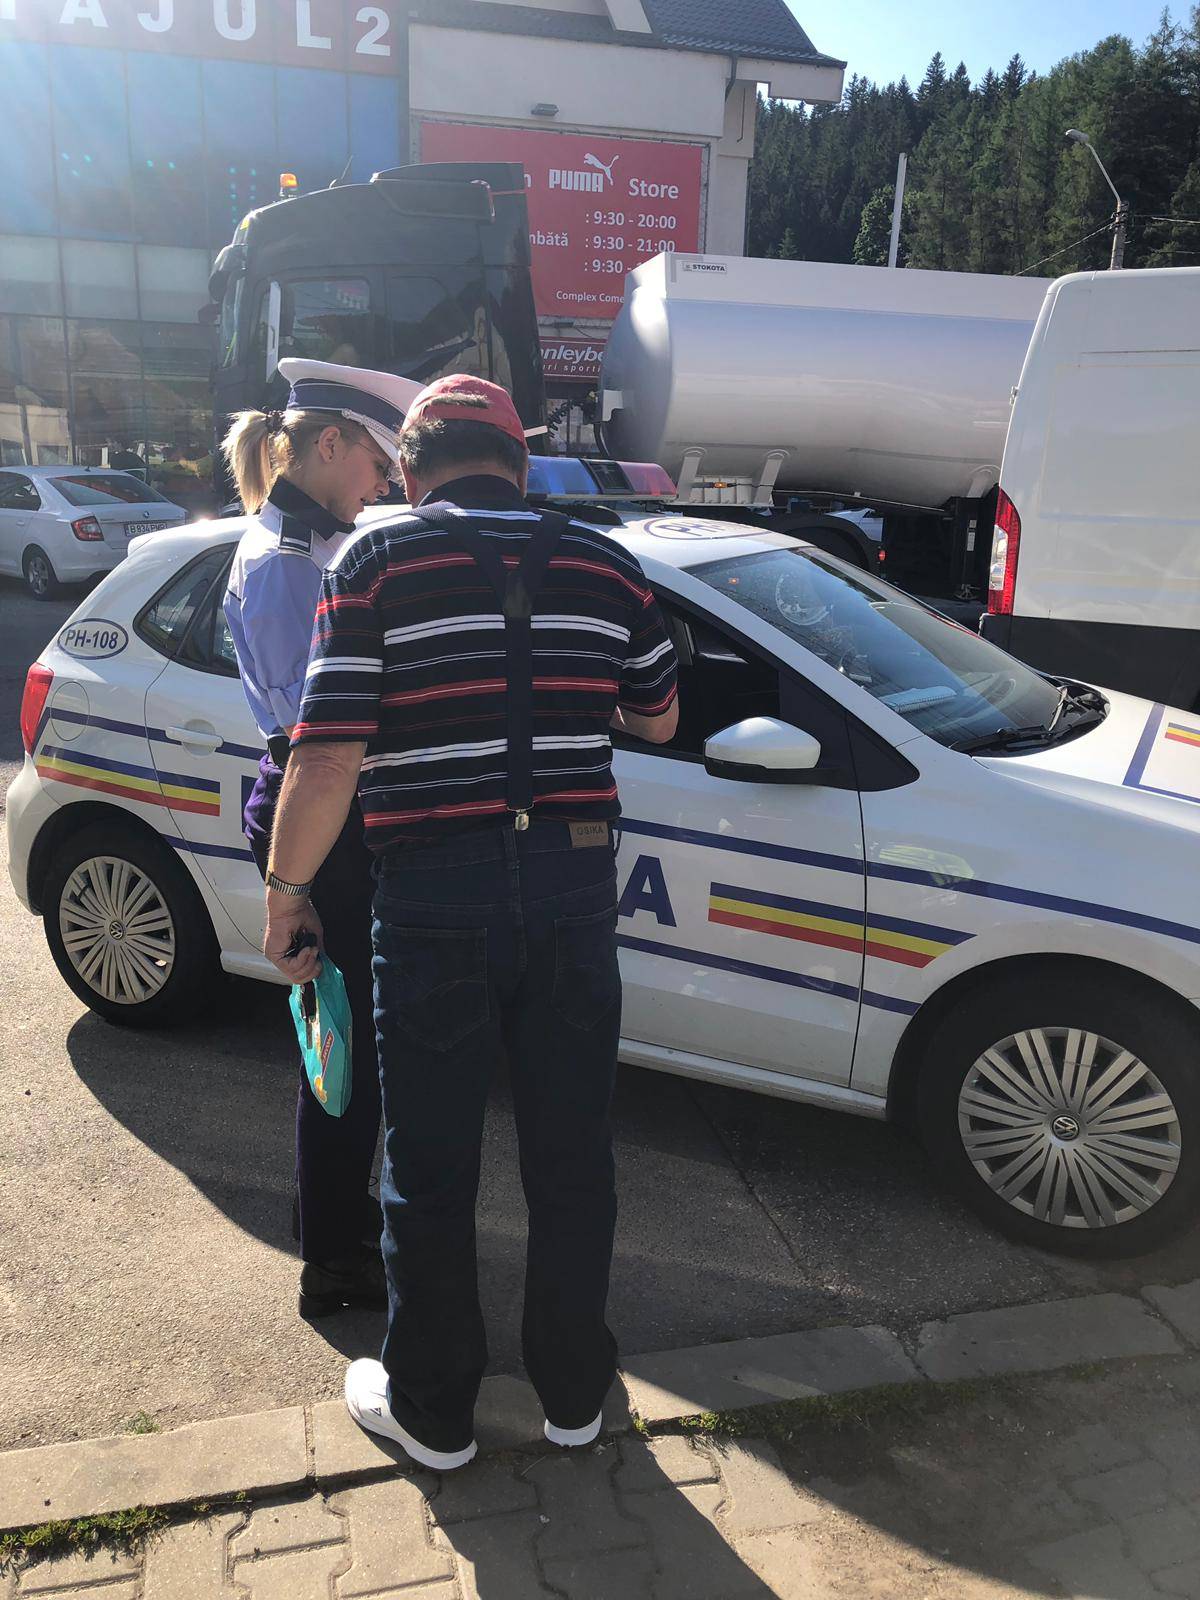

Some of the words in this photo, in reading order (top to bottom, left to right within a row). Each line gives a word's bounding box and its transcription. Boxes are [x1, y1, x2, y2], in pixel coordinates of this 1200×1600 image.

[548, 168, 604, 193] PUMA
[628, 177, 679, 199] Store
[593, 210, 625, 226] 9:30
[637, 213, 677, 229] 20:00
[592, 236, 624, 250] 9:30
[636, 238, 676, 253] 21:00
[591, 259, 623, 274] 9:30
[692, 264, 726, 272] STOKOTA
[556, 290, 597, 304] Complex
[599, 292, 625, 304] Come
[64, 629, 119, 650] PH-108
